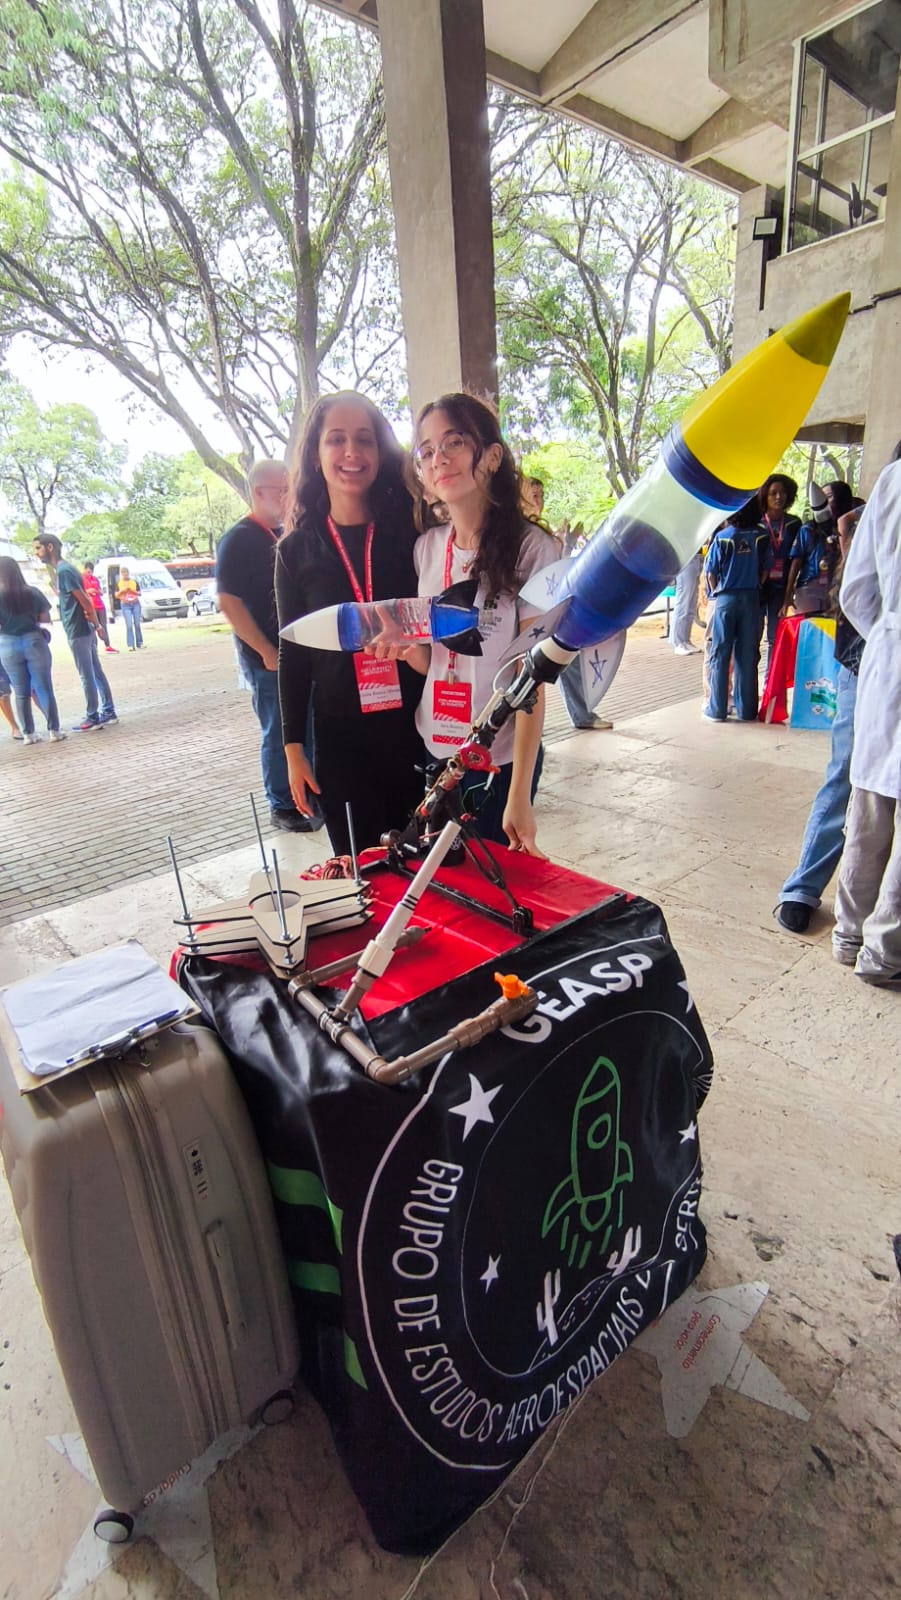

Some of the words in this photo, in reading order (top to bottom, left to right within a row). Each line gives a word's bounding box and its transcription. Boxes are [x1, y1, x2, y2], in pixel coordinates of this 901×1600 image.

[500, 953, 654, 1044] GEASP
[392, 1159, 464, 1280] GRUPO
[393, 1294, 441, 1332] DE
[682, 1313, 721, 1370] Conhecimento
[404, 1343, 503, 1443] ESTUDOS
[496, 1286, 644, 1444] AEROESPACIAIS
